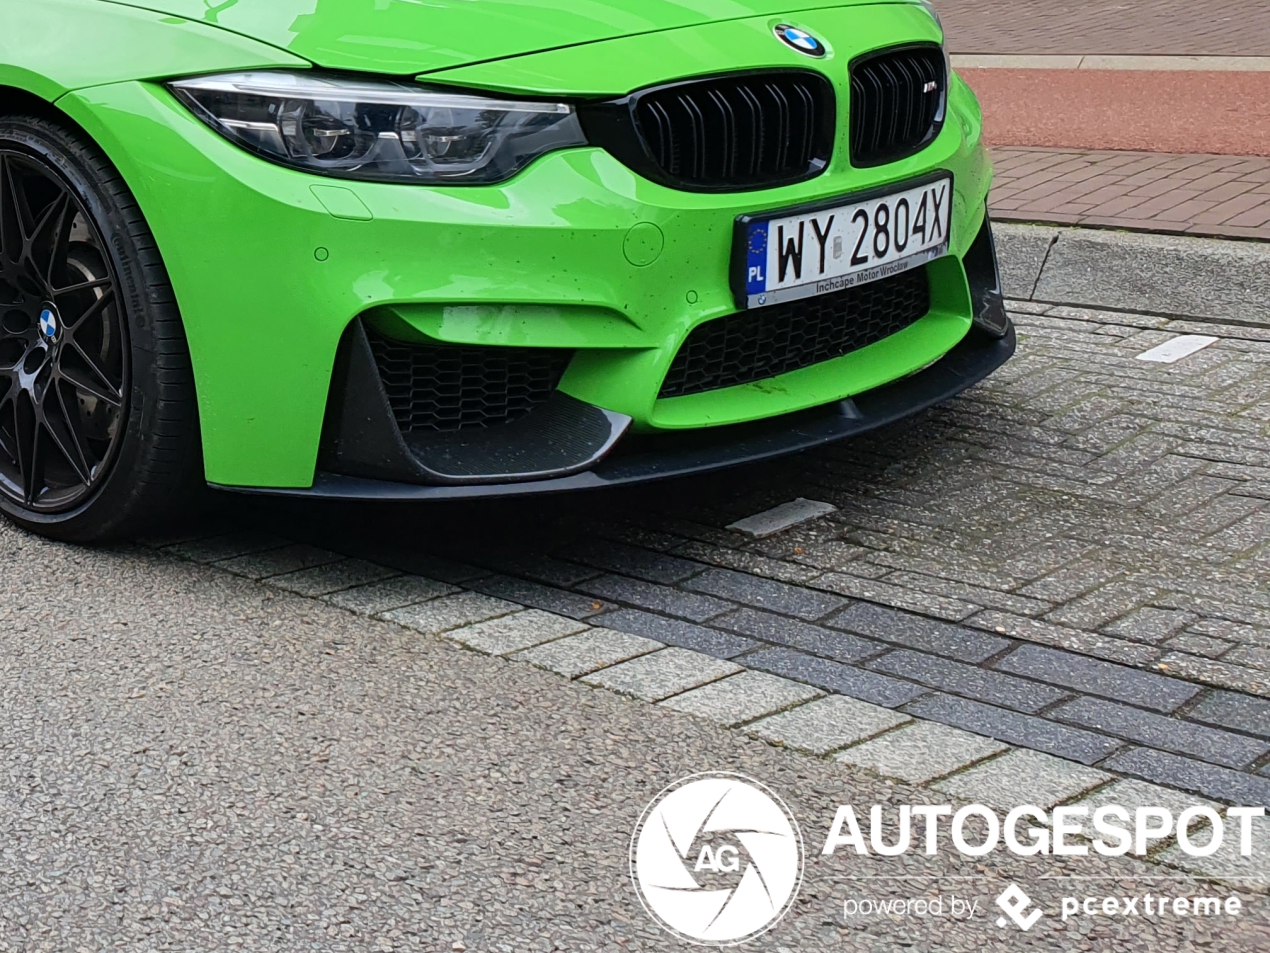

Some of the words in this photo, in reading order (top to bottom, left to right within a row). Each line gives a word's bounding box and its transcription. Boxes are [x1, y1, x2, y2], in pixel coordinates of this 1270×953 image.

[777, 215, 835, 284] WY
[849, 184, 946, 267] 2804X
[748, 266, 764, 284] PL
[816, 277, 854, 294] Inchcape
[856, 269, 879, 283] Motor
